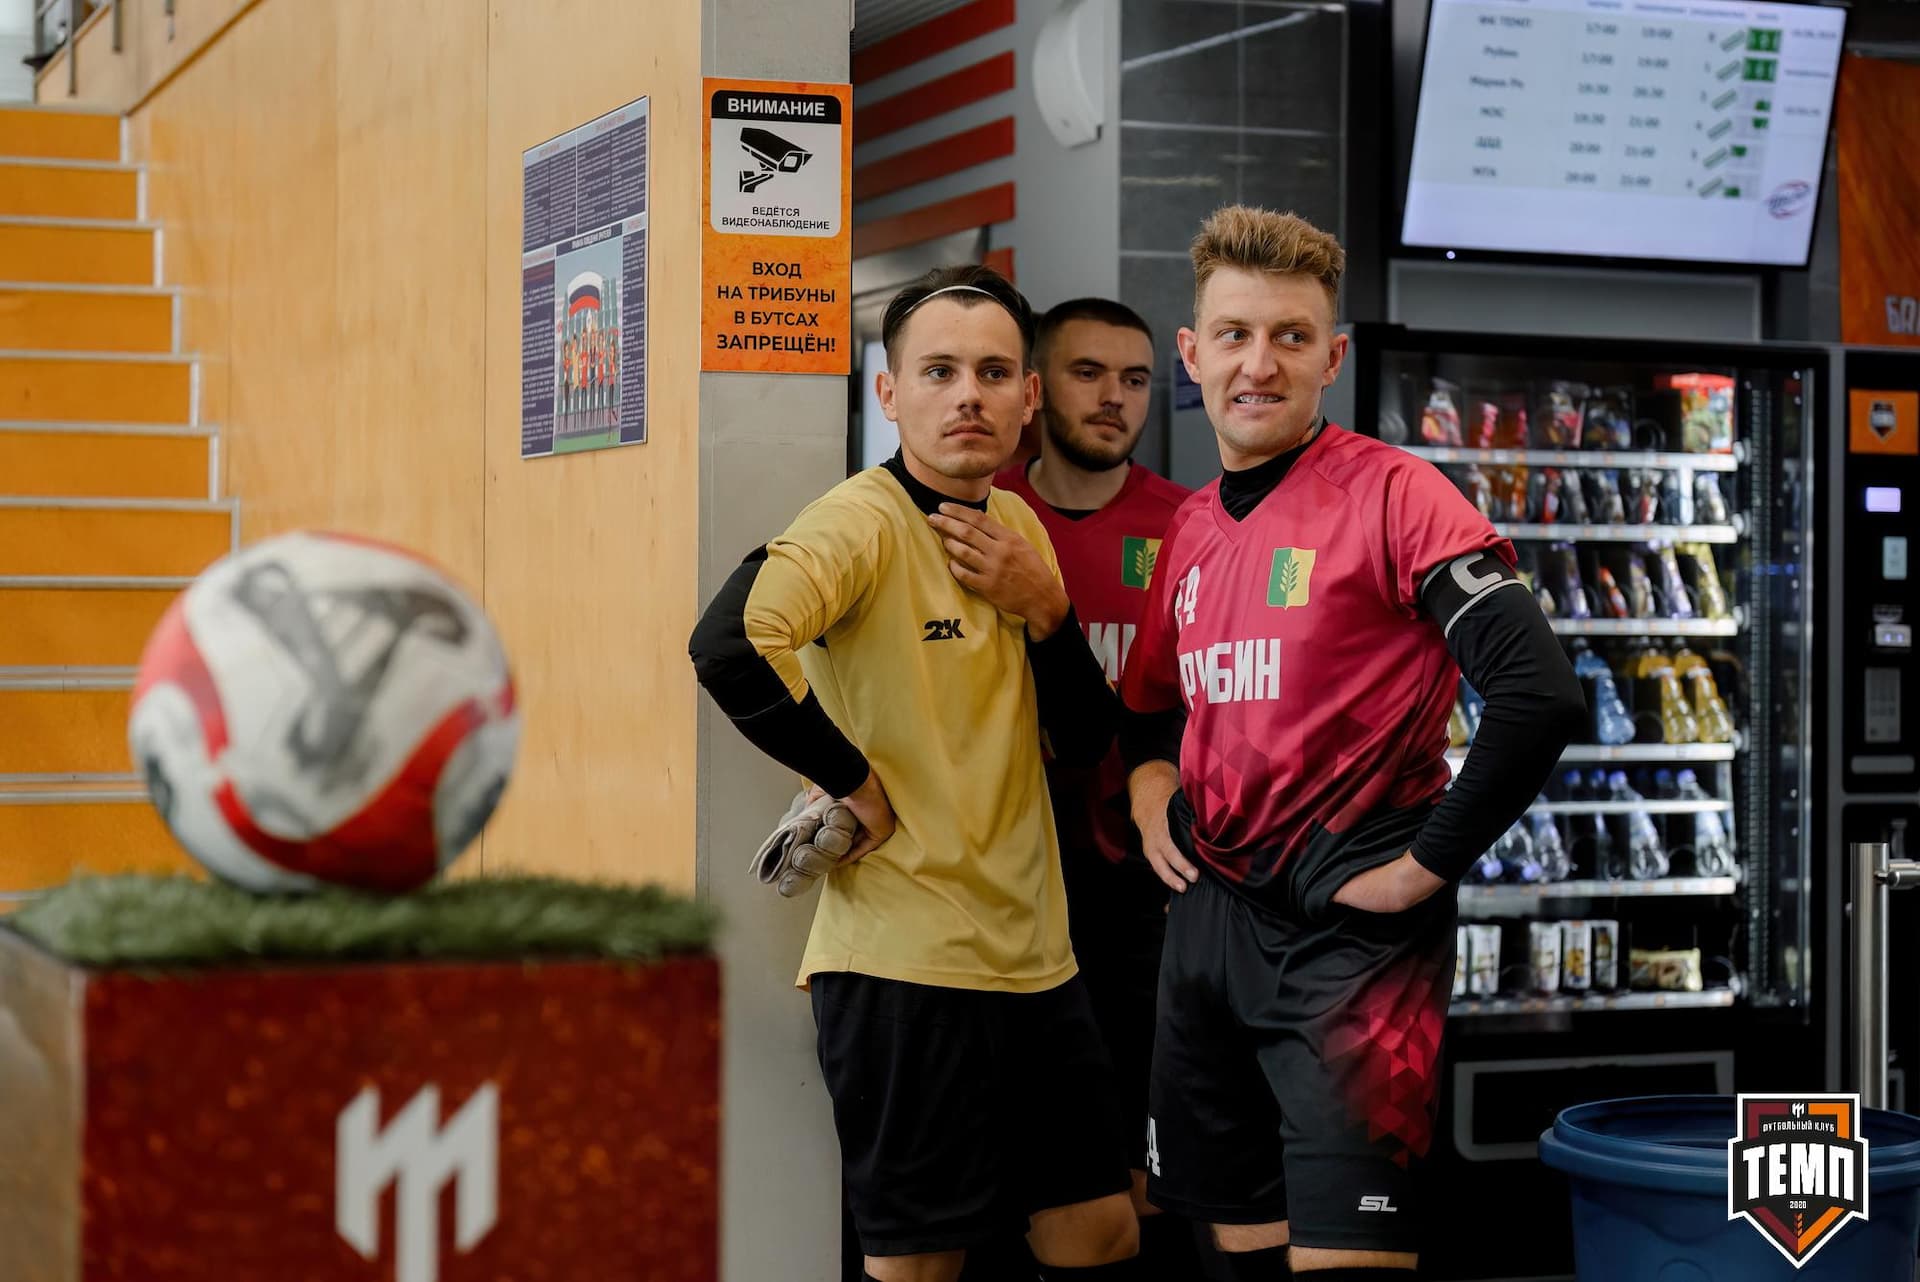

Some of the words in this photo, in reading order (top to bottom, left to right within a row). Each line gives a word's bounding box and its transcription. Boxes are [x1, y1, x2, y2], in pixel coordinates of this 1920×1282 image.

[727, 97, 826, 117] ВНИМАНИЕ
[752, 206, 800, 218] ВЕДЁТСЯ
[722, 216, 830, 230] ВИДЕОНАБЛЮДЕНИЕ
[752, 262, 802, 279] ВХОД
[717, 285, 743, 300] НА
[748, 287, 835, 303] ТРИБУНЫ
[734, 311, 745, 324] В
[752, 312, 818, 327] БУТСАХ
[717, 334, 836, 354] ЗАПРЕЩЁН!
[921, 618, 966, 642] 2K
[1179, 638, 1281, 712] РУБИН
[1358, 1195, 1398, 1212] SL
